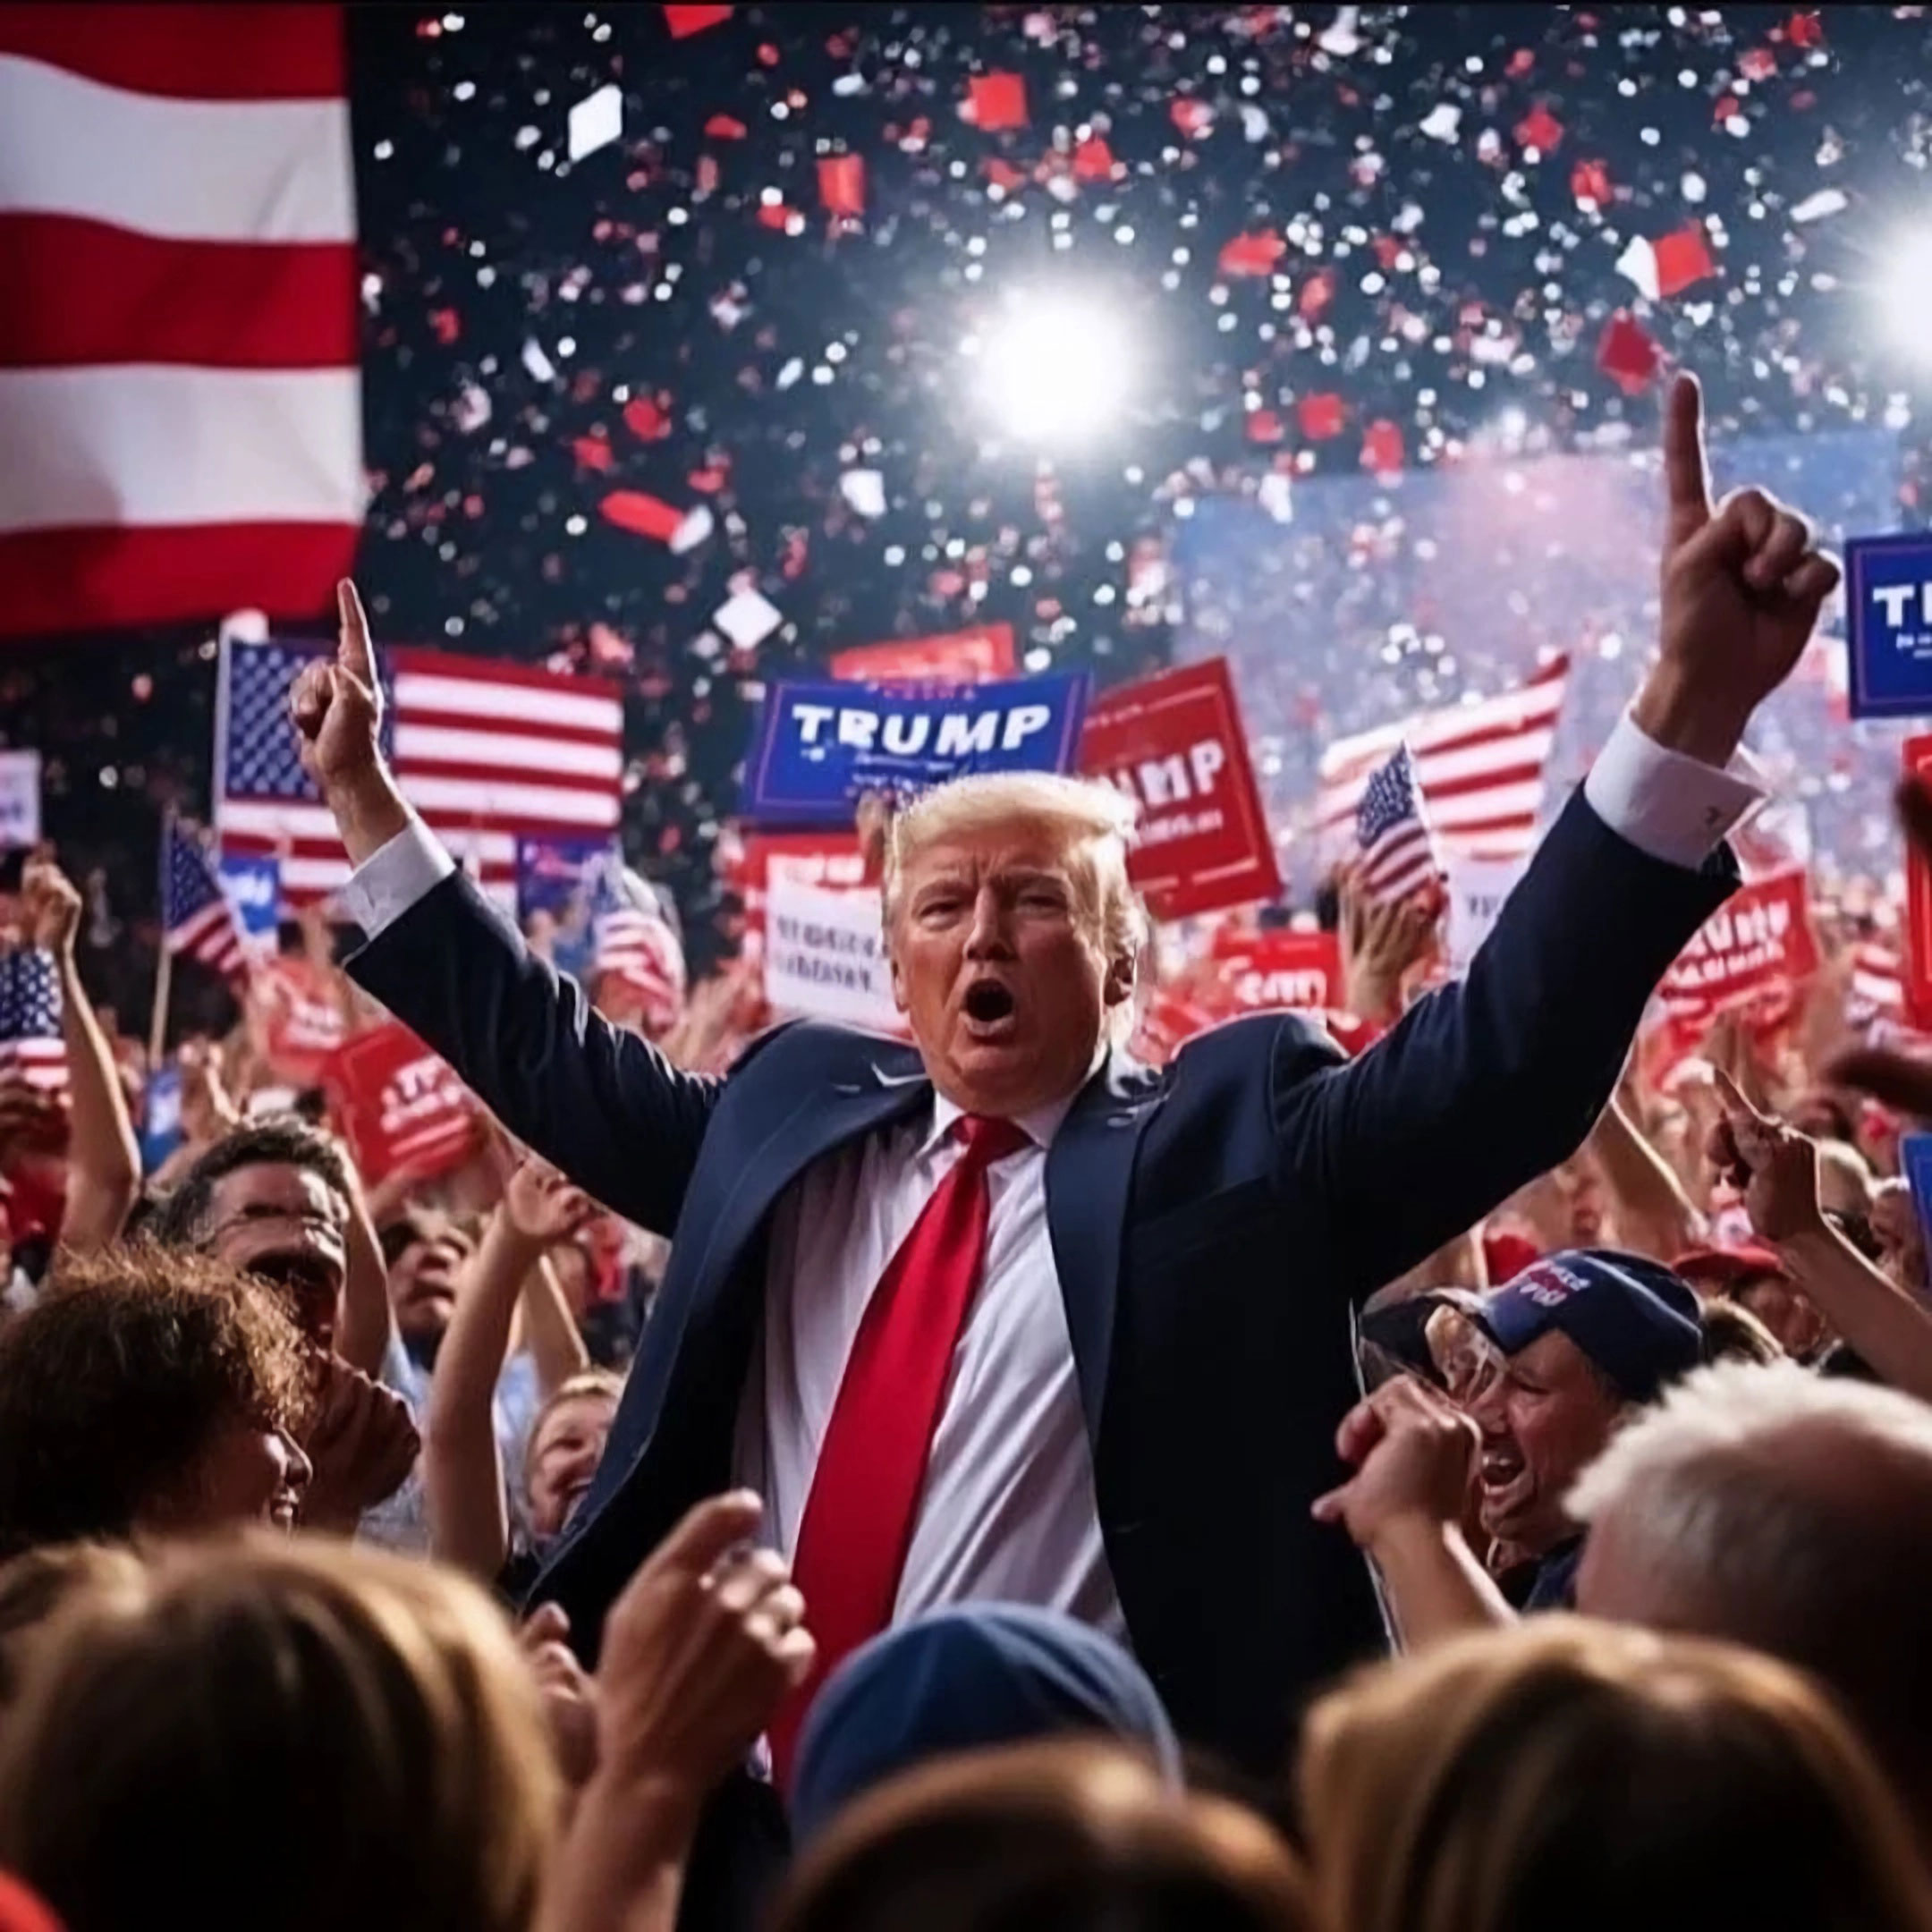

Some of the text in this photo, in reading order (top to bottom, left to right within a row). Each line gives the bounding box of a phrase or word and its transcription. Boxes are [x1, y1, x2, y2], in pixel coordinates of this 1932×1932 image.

[1873, 581, 1932, 628] T
[792, 704, 1051, 756] TRUMP
[1117, 738, 1224, 809] MP
